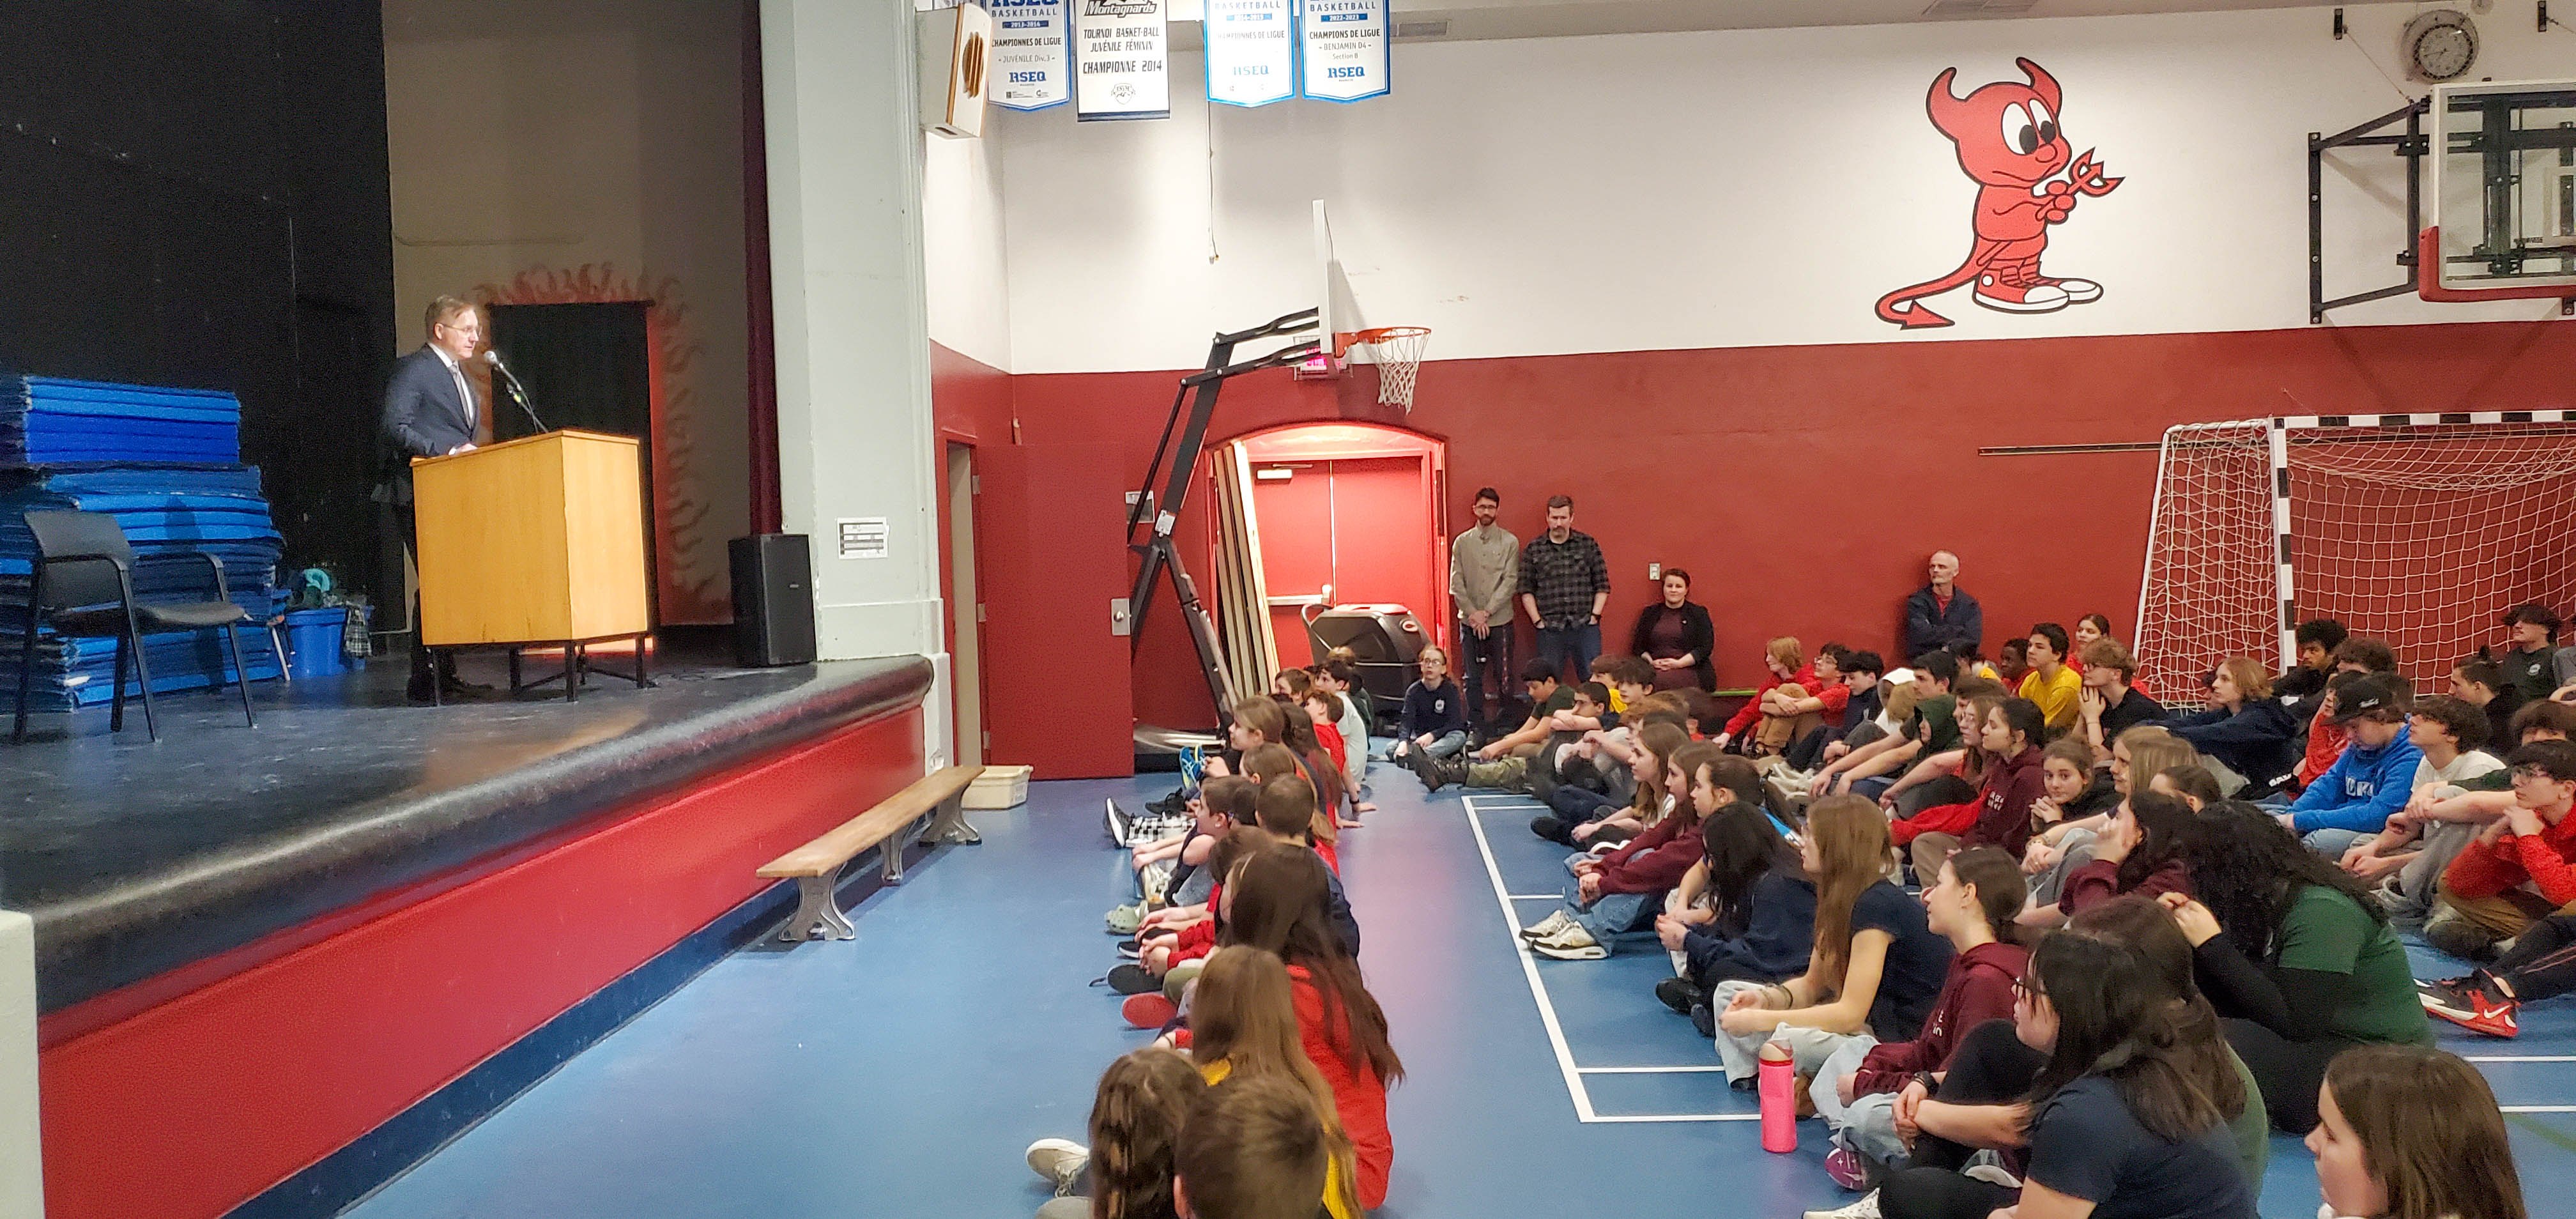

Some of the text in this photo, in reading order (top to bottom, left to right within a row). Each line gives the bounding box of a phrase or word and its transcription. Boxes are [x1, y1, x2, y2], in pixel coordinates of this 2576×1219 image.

[1084, 0, 1157, 18] Montagnards
[1215, 1, 1280, 10] BASKETBALL
[1310, 1, 1376, 12] BASKETBALL
[992, 8, 1057, 17] BASKETBALL
[1084, 27, 1159, 39] TOURNOI BASKET-BALL
[1217, 31, 1256, 40] HAMPIONNES
[1267, 30, 1285, 38] LIGUE
[1309, 29, 1380, 39] CHAMPIONS DE LIGUE
[992, 37, 1061, 47] CHAMPIONNES DE LIGUE
[1090, 38, 1153, 52] JUVÉNILE FÉMININ
[1324, 42, 1356, 50] BENJAMIN
[1083, 59, 1162, 74] CHAMPIONNE 2014
[1328, 66, 1365, 78] RSEQ
[1009, 71, 1046, 83] RSEQ
